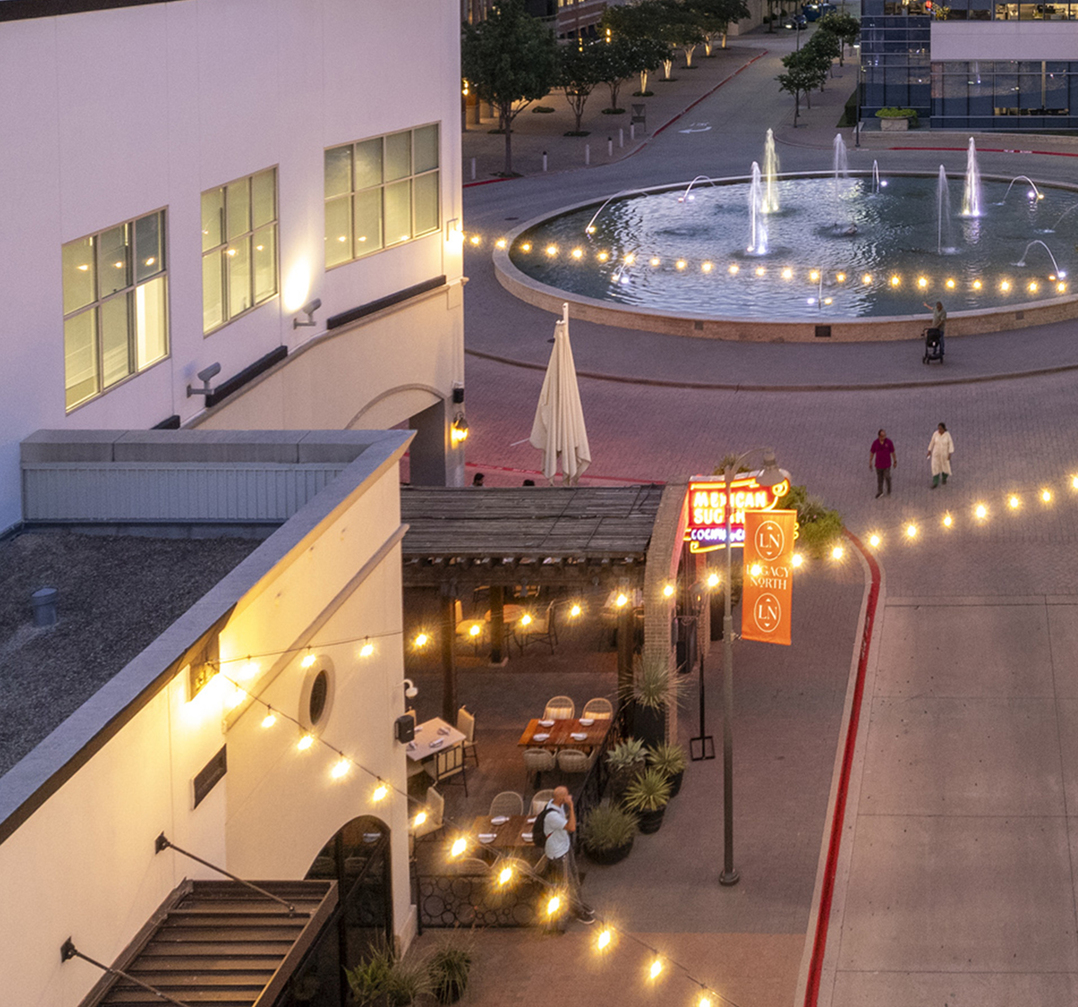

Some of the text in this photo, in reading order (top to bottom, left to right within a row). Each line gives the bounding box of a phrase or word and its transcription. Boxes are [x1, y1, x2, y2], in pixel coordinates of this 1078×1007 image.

[693, 491, 768, 508] MEXICAN
[760, 533, 780, 548] LN
[746, 564, 789, 578] LGACY
[750, 576, 787, 590] NORTH
[758, 604, 777, 620] LN
